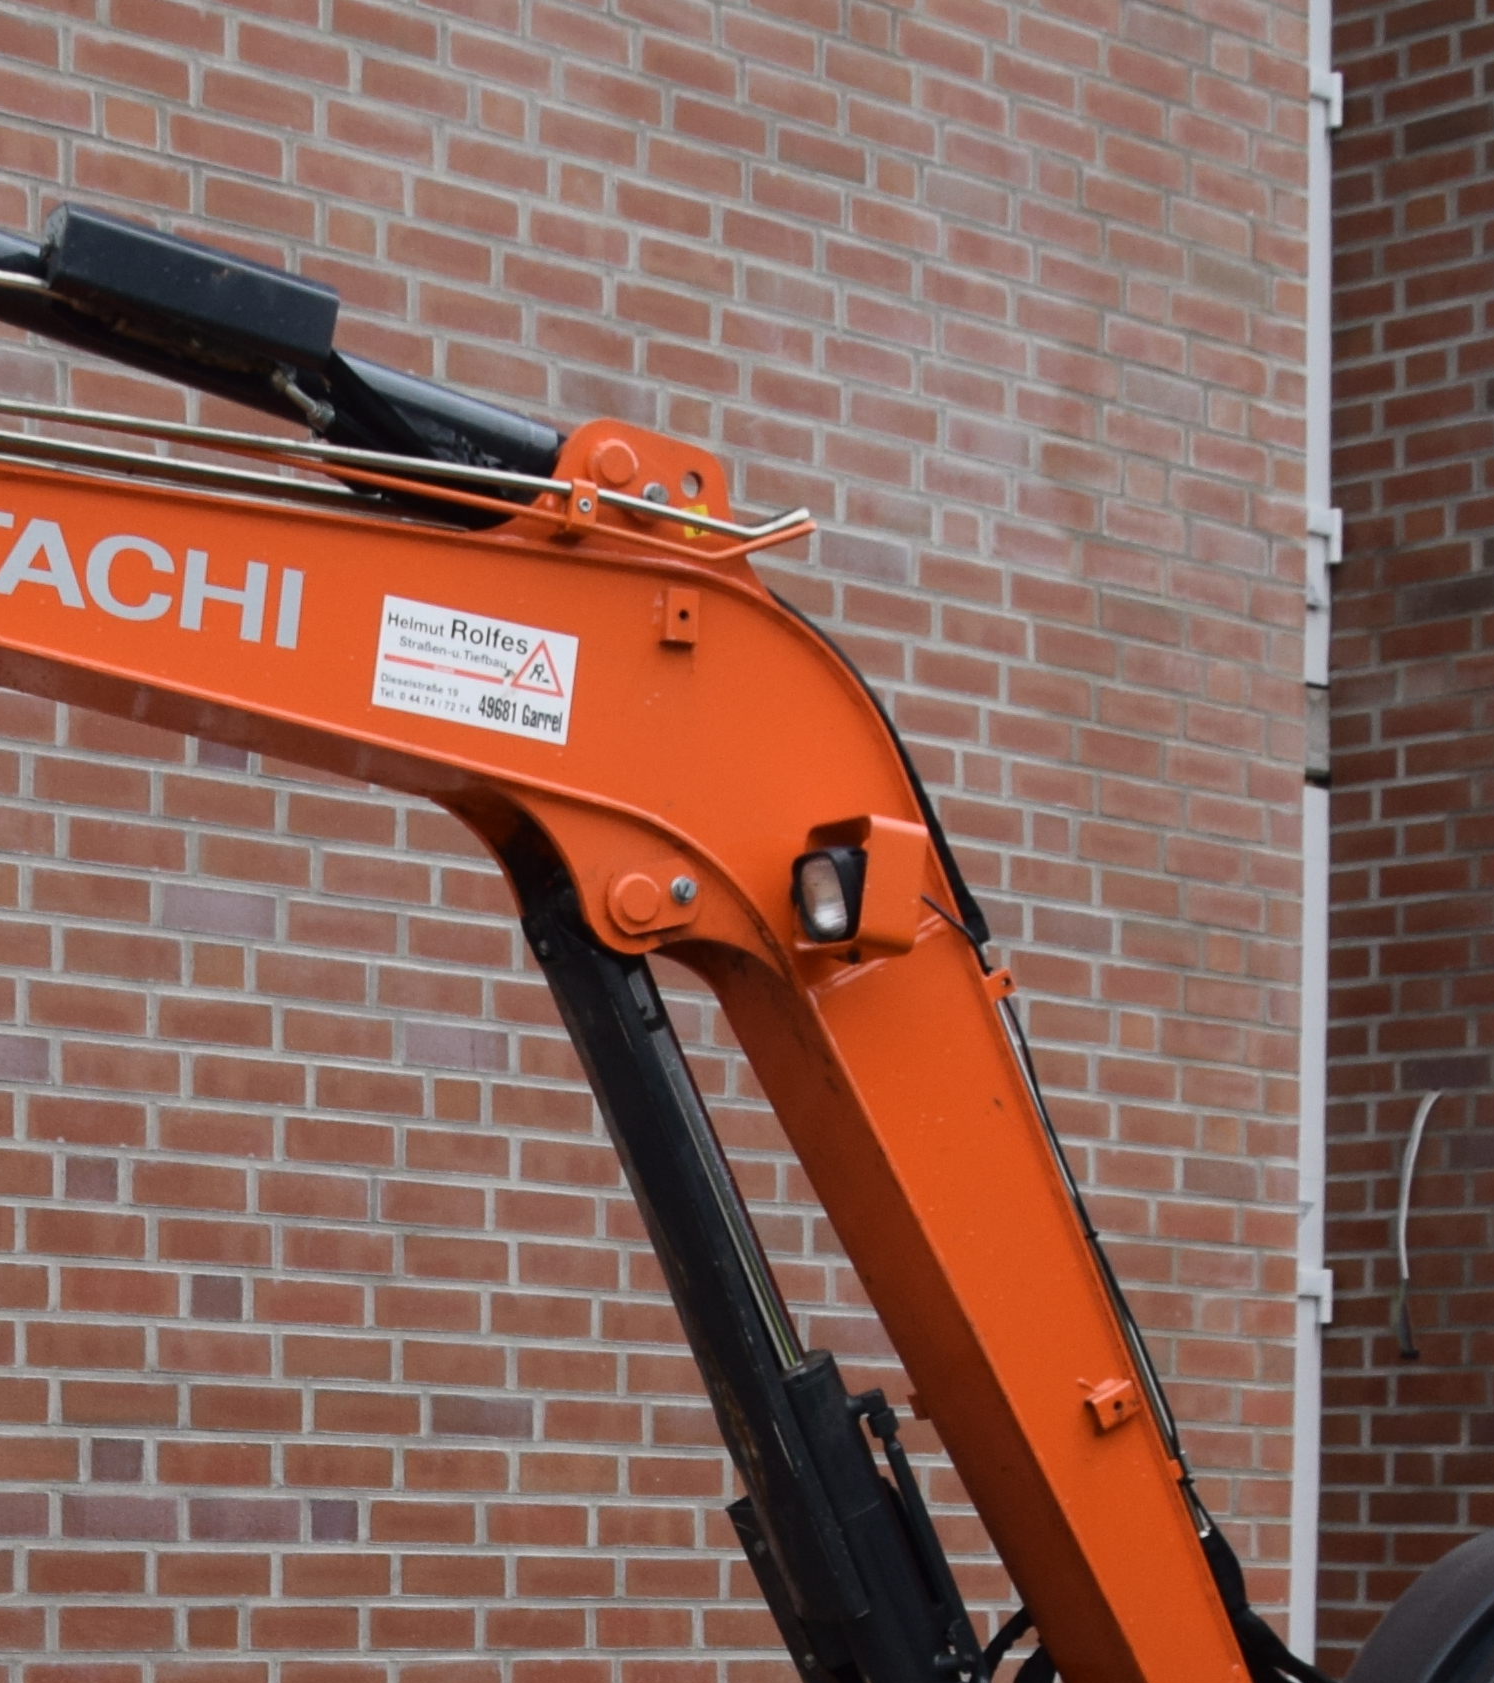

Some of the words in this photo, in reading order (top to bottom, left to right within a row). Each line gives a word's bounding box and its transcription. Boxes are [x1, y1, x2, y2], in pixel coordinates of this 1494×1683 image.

[387, 612, 445, 637] Helmut
[450, 618, 529, 656] Rolfes
[380, 687, 396, 699] Tel.
[381, 672, 444, 696] Dieselstraße
[478, 694, 518, 724] 49681
[522, 703, 564, 734] Garrel
